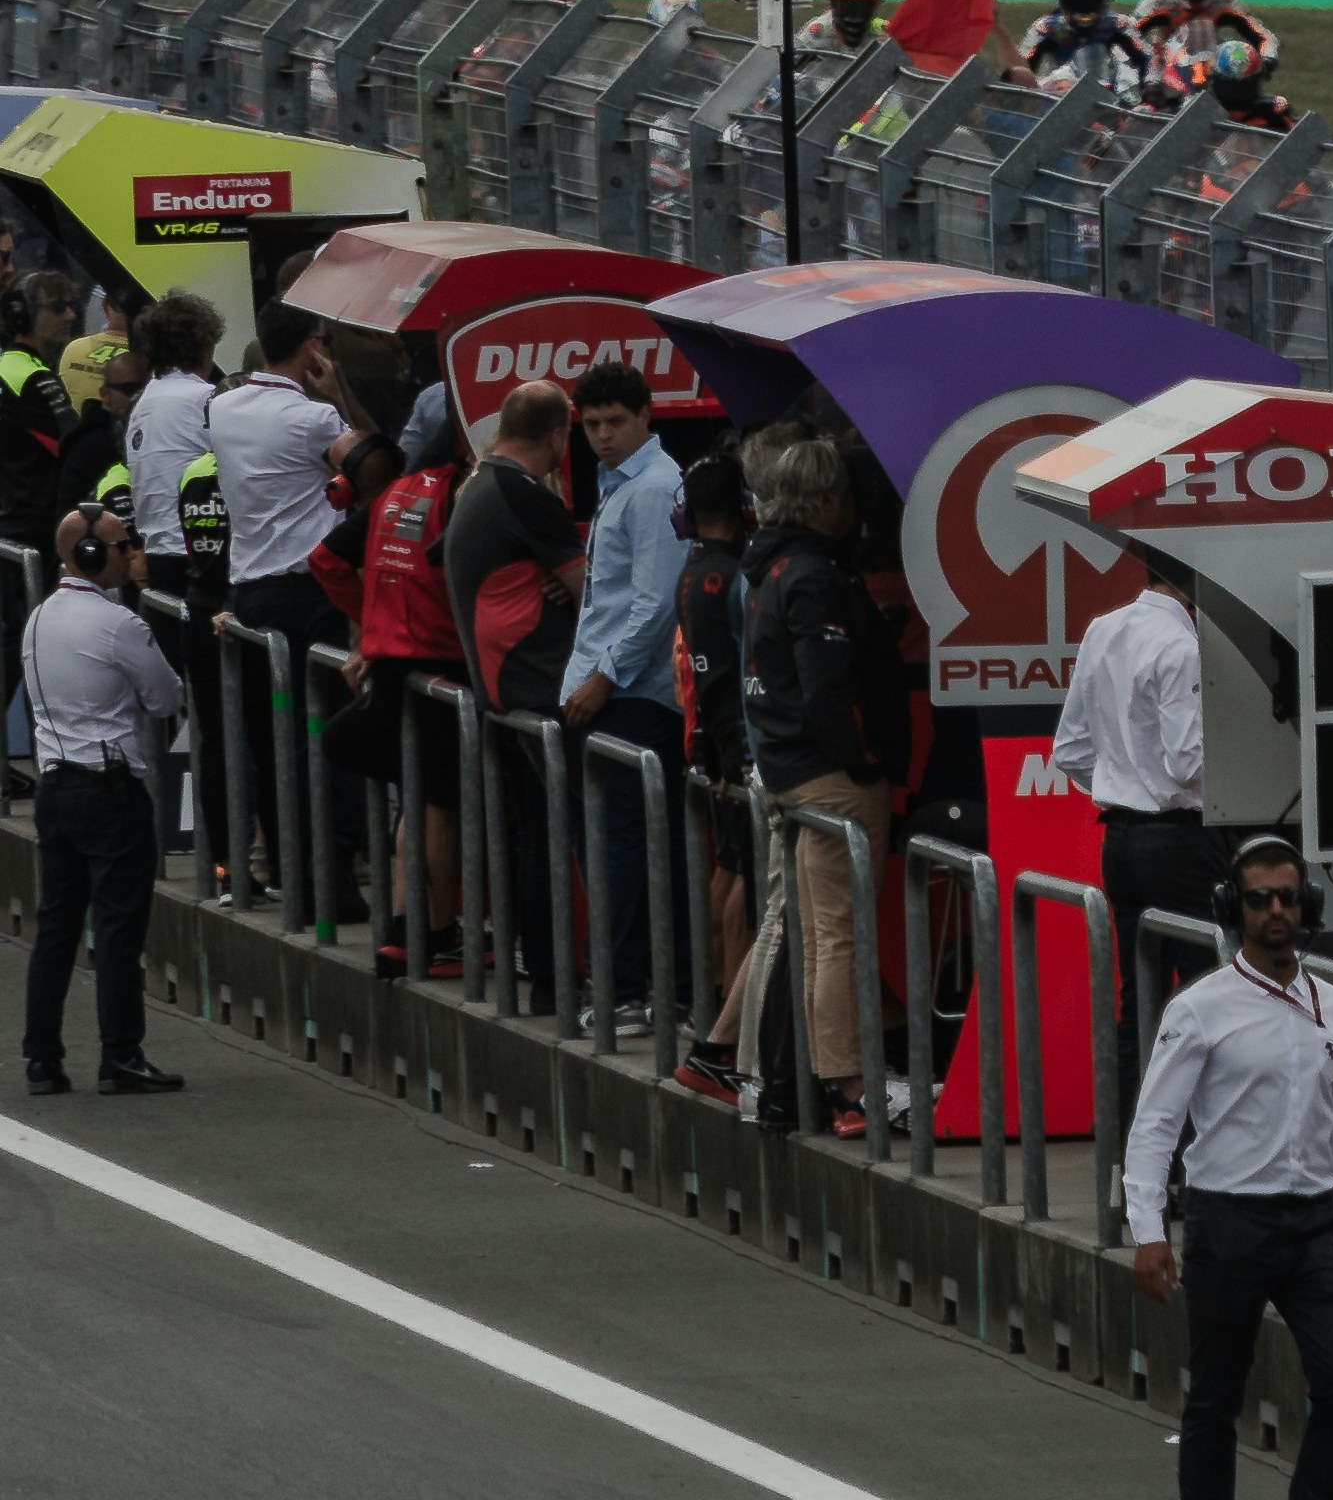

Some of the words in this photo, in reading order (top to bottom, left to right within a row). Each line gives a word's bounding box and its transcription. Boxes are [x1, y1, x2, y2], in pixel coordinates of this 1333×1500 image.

[153, 189, 272, 211] Enduro
[475, 338, 674, 382] DUCATI
[940, 656, 1078, 692] PRA
